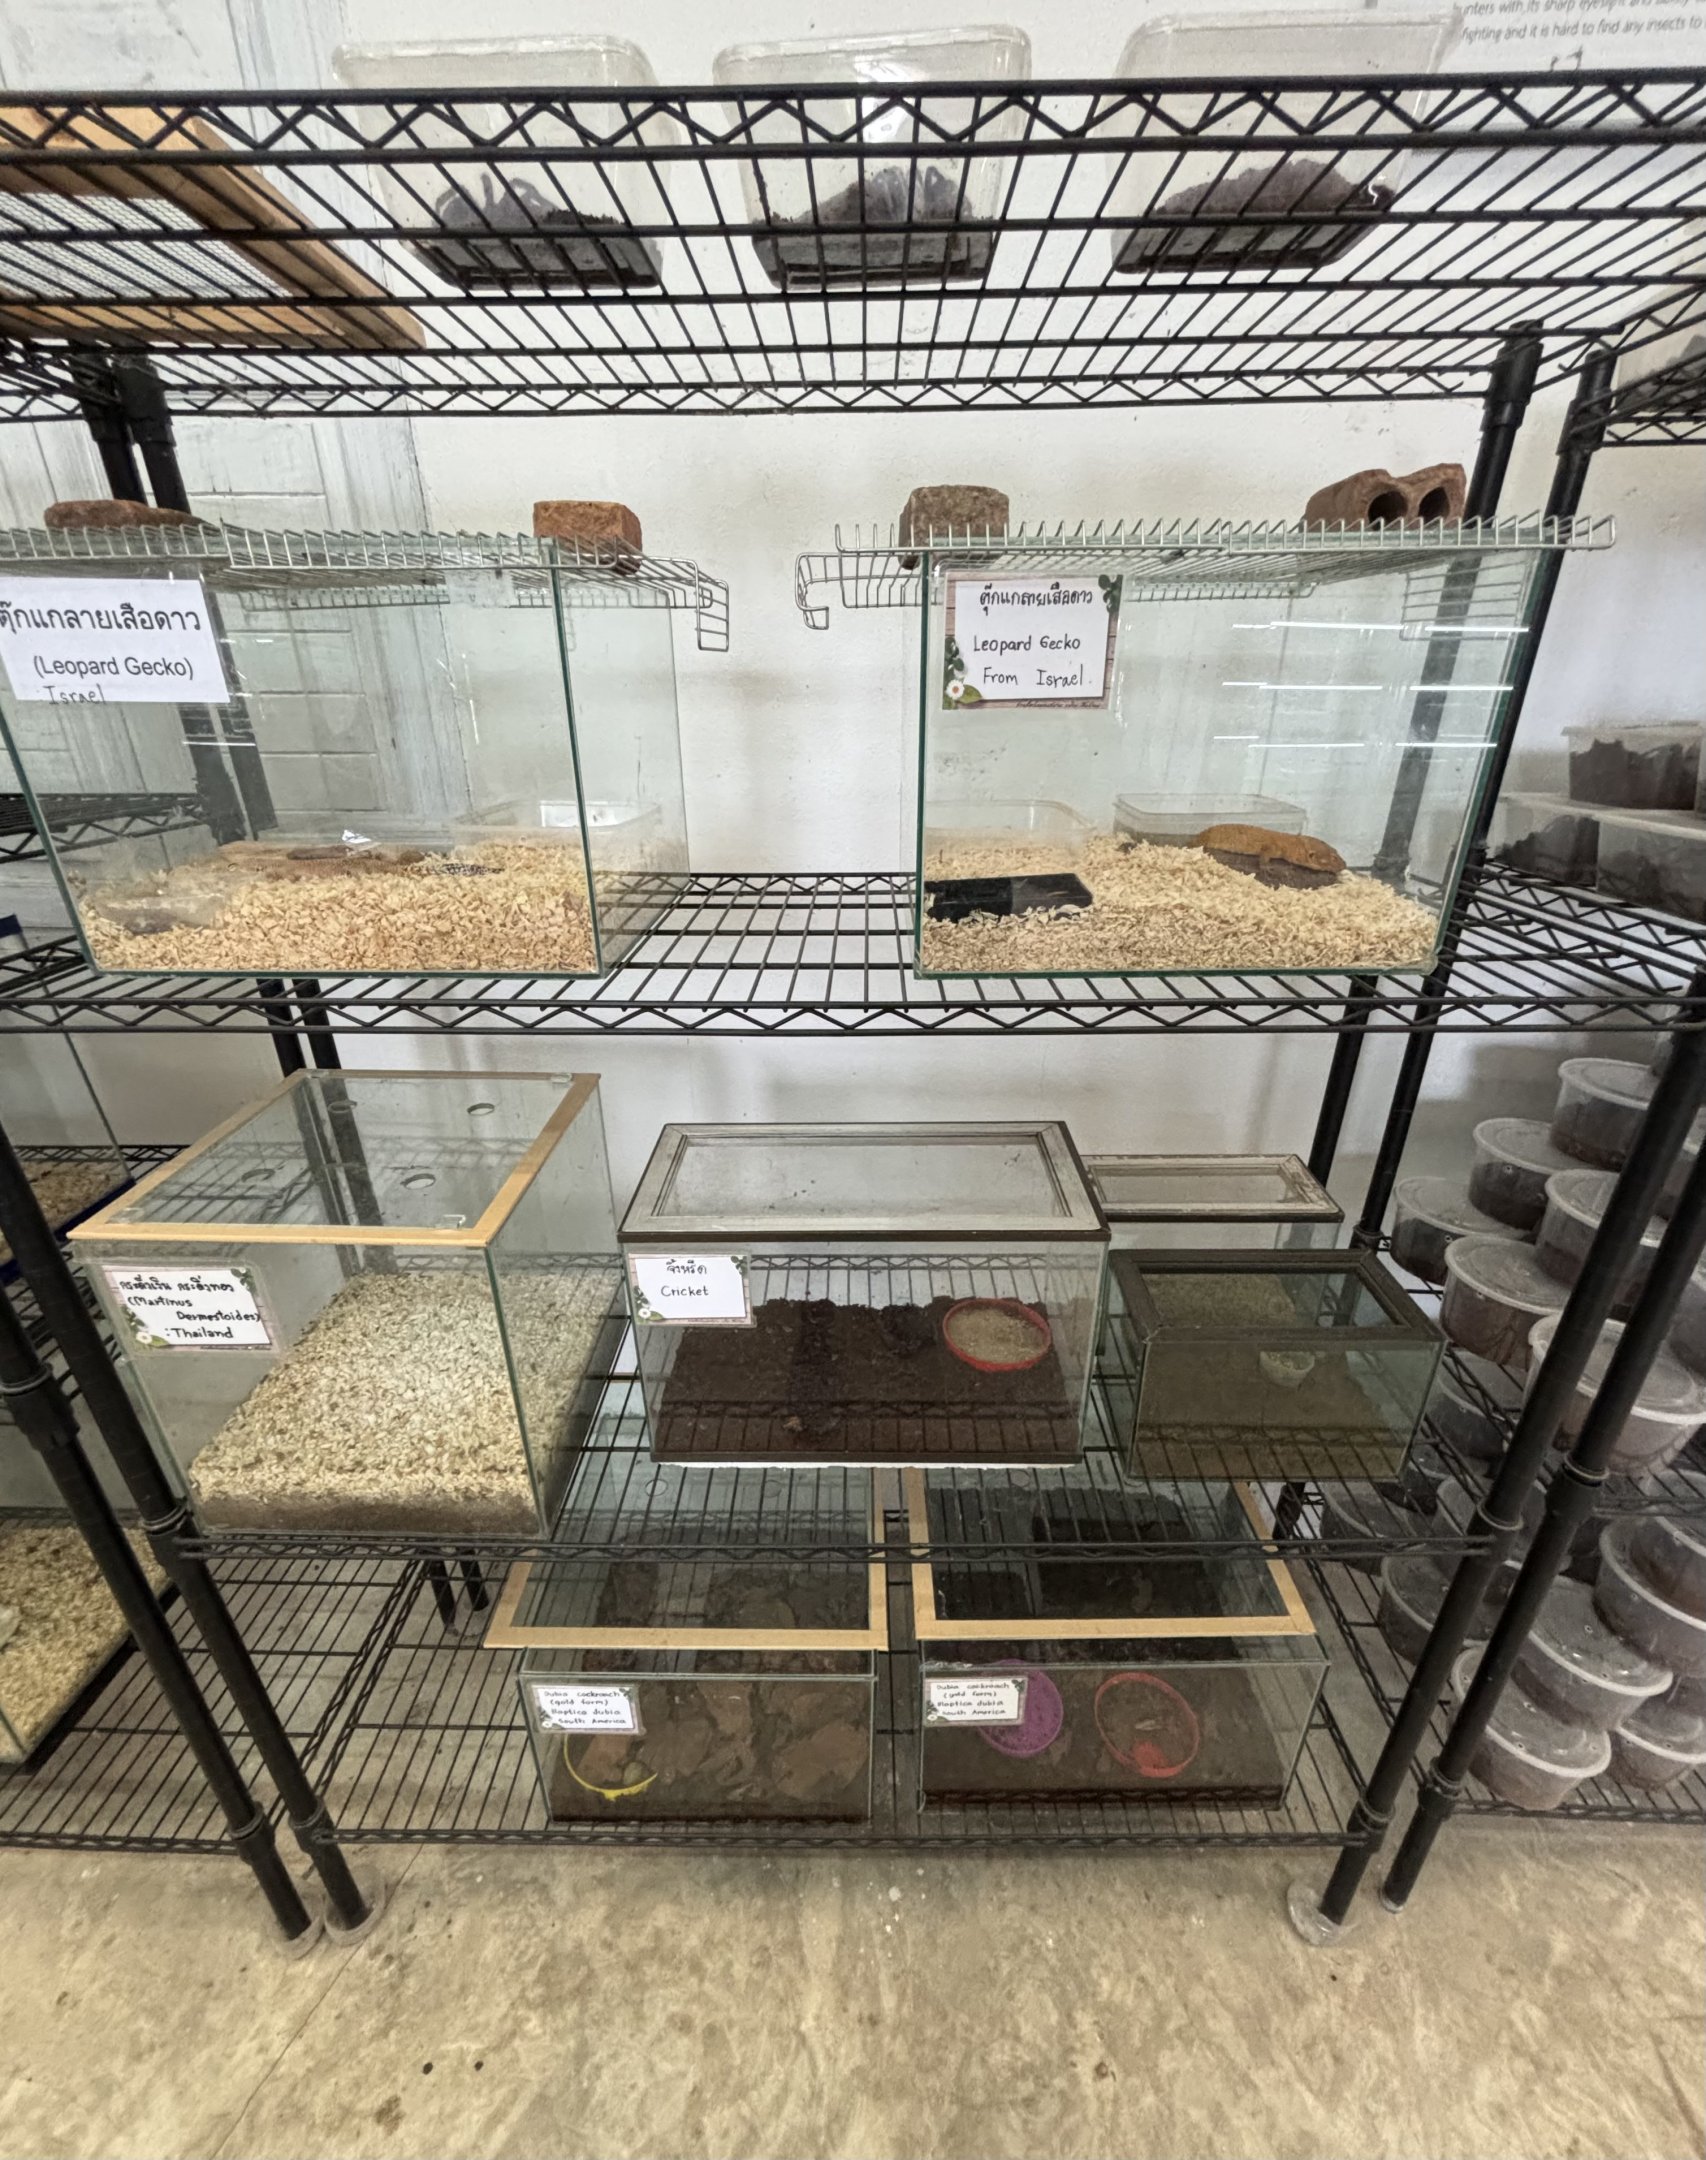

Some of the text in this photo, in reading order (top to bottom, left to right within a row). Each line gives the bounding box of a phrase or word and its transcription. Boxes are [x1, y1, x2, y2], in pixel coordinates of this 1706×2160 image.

[1504, 24, 1527, 40] and
[1530, 24, 1538, 38] it
[1541, 24, 1549, 37] is
[1553, 21, 1579, 36] hard
[1582, 22, 1594, 36] to
[1597, 18, 1620, 34] find
[1623, 20, 1644, 36] any
[1646, 16, 1686, 32] insects
[1689, 15, 1703, 29] to
[973, 633, 1081, 656] Leopard Gecko
[33, 655, 194, 680] (Leopard Gecko)
[983, 667, 1019, 686] From
[43, 683, 107, 705] Israel
[660, 1285, 709, 1297] Cricket
